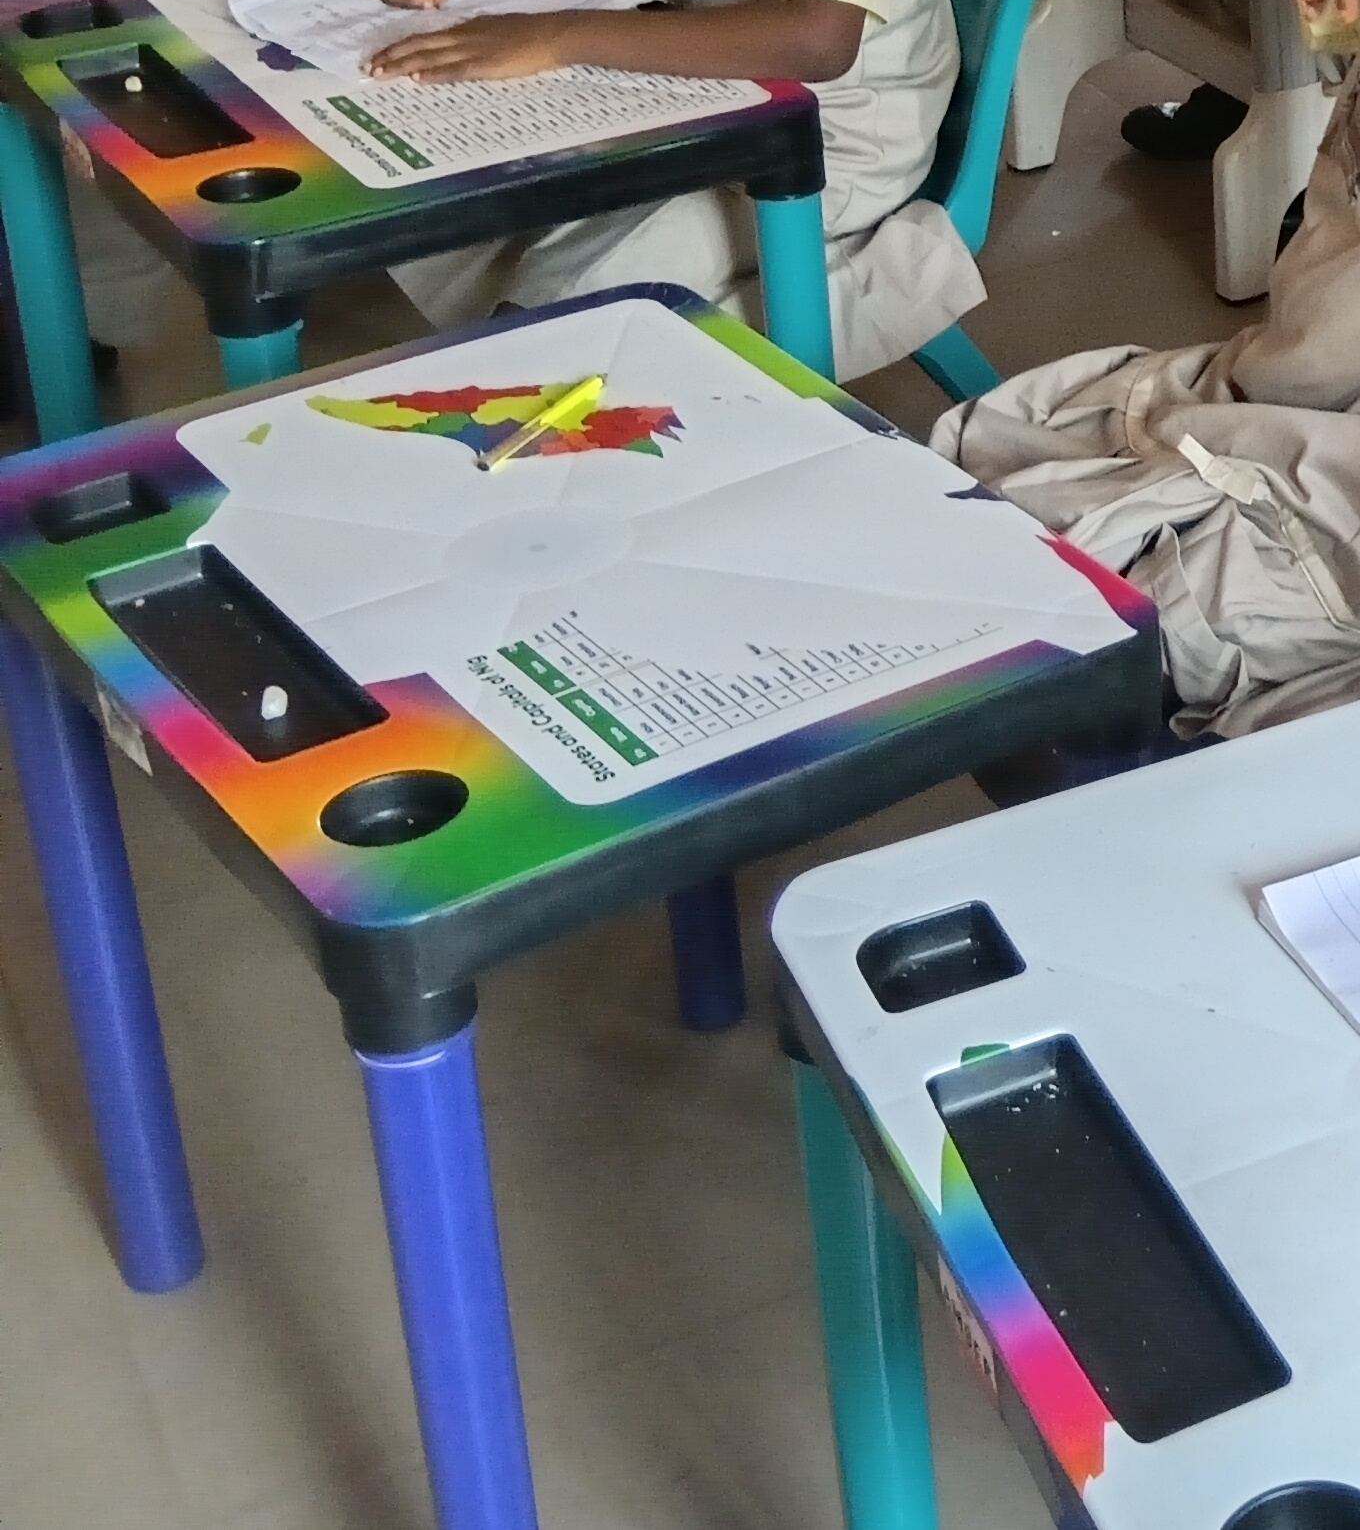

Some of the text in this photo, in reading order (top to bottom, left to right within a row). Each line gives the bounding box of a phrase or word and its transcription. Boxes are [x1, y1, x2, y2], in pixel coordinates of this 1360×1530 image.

[504, 683, 552, 727] Capitals
[548, 721, 577, 747] and
[571, 742, 615, 782] States
